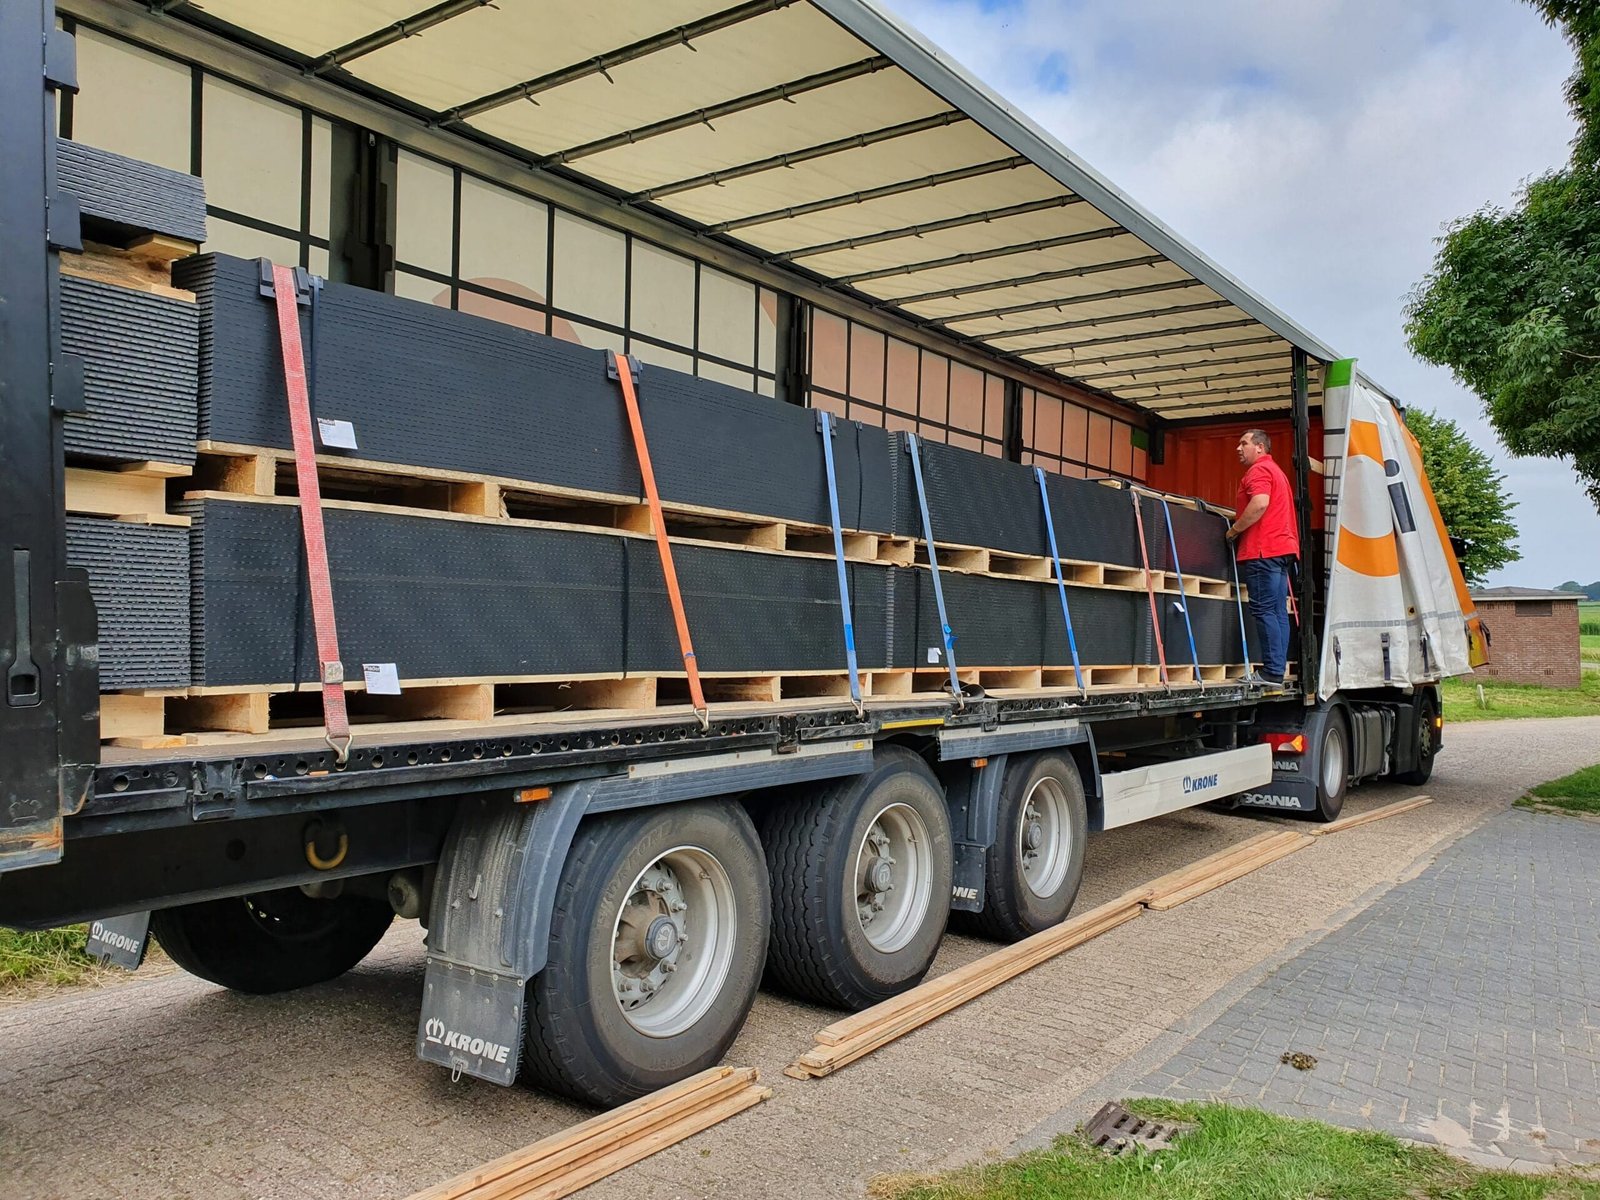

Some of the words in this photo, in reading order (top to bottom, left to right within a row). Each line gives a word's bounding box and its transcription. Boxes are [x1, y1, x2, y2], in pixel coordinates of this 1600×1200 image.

[1191, 774, 1218, 791] KRONE
[101, 930, 140, 954] KRONE
[444, 1030, 511, 1064] KRONE
